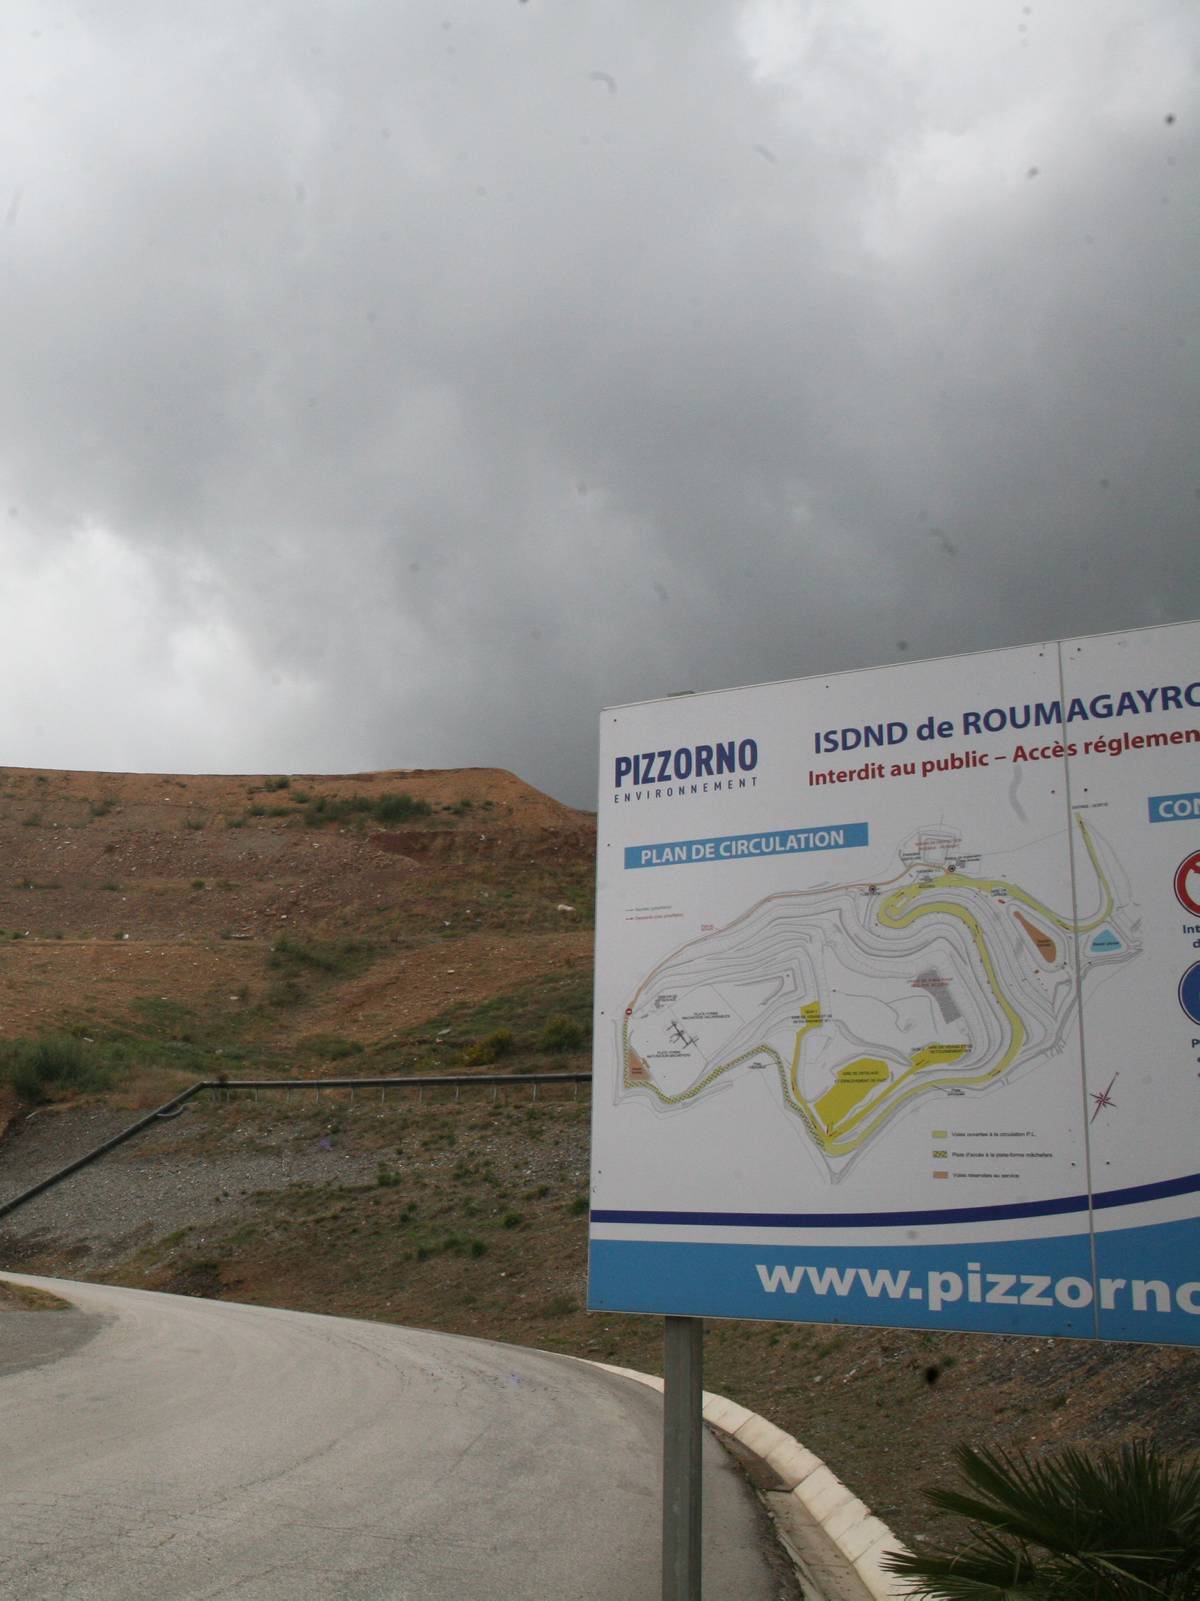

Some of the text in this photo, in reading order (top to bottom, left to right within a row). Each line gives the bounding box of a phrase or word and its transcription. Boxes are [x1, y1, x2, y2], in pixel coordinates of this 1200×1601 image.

[814, 721, 908, 754] ISDND
[916, 716, 954, 741] de
[614, 738, 758, 788] PIZZORNO
[809, 762, 886, 786] Interdit
[890, 761, 916, 777] au
[922, 750, 990, 777] public
[1012, 740, 1077, 763] Accès
[614, 776, 758, 804] ENVIRONNEMENT
[641, 829, 844, 865] PLAN DE CIRCULATION
[756, 1262, 1200, 1316] www.pizzorno
